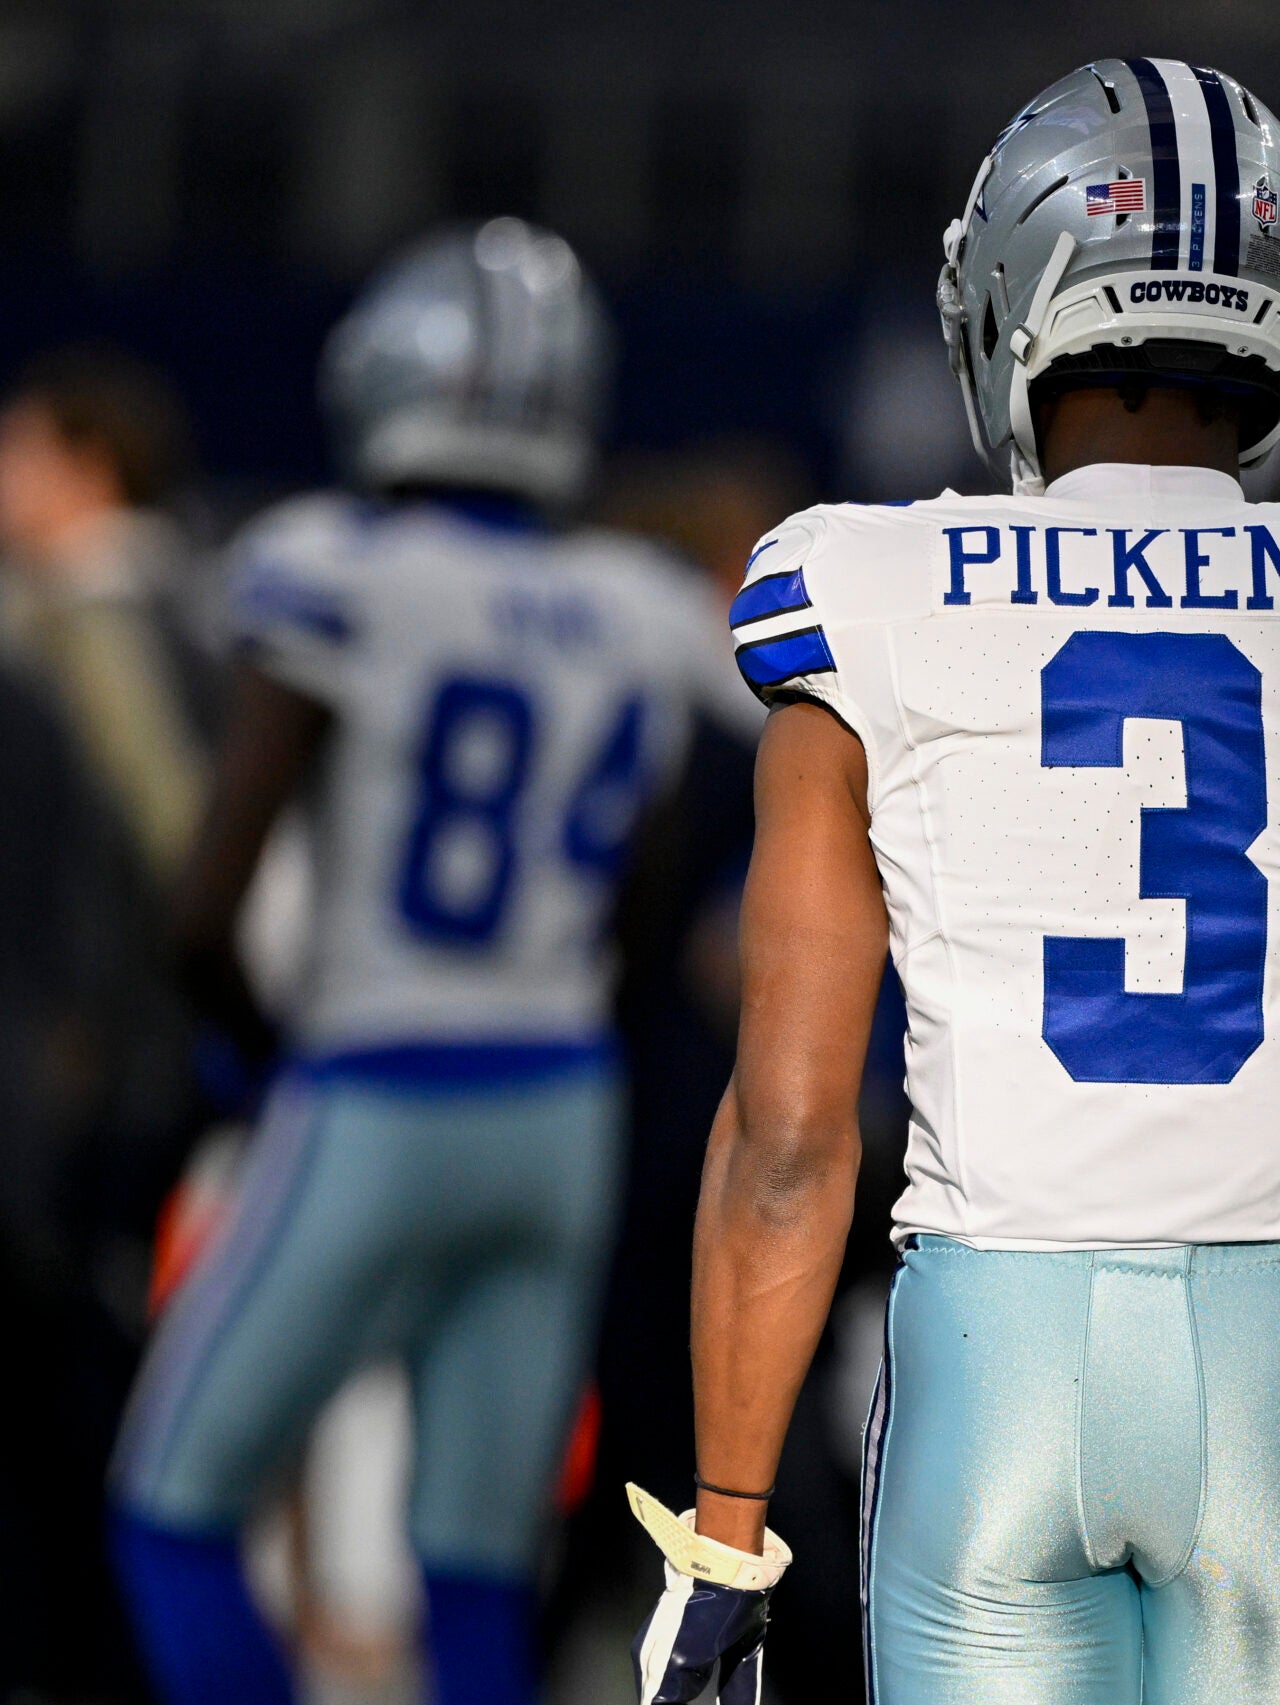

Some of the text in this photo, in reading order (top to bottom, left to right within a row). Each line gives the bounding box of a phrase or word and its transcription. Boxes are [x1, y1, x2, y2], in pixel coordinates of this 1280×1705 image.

[1192, 193, 1203, 251] PICKENS
[1255, 199, 1275, 221] NFL
[1130, 280, 1249, 312] COWBOYS
[398, 673, 655, 948] 84
[1041, 631, 1268, 1084] 3
